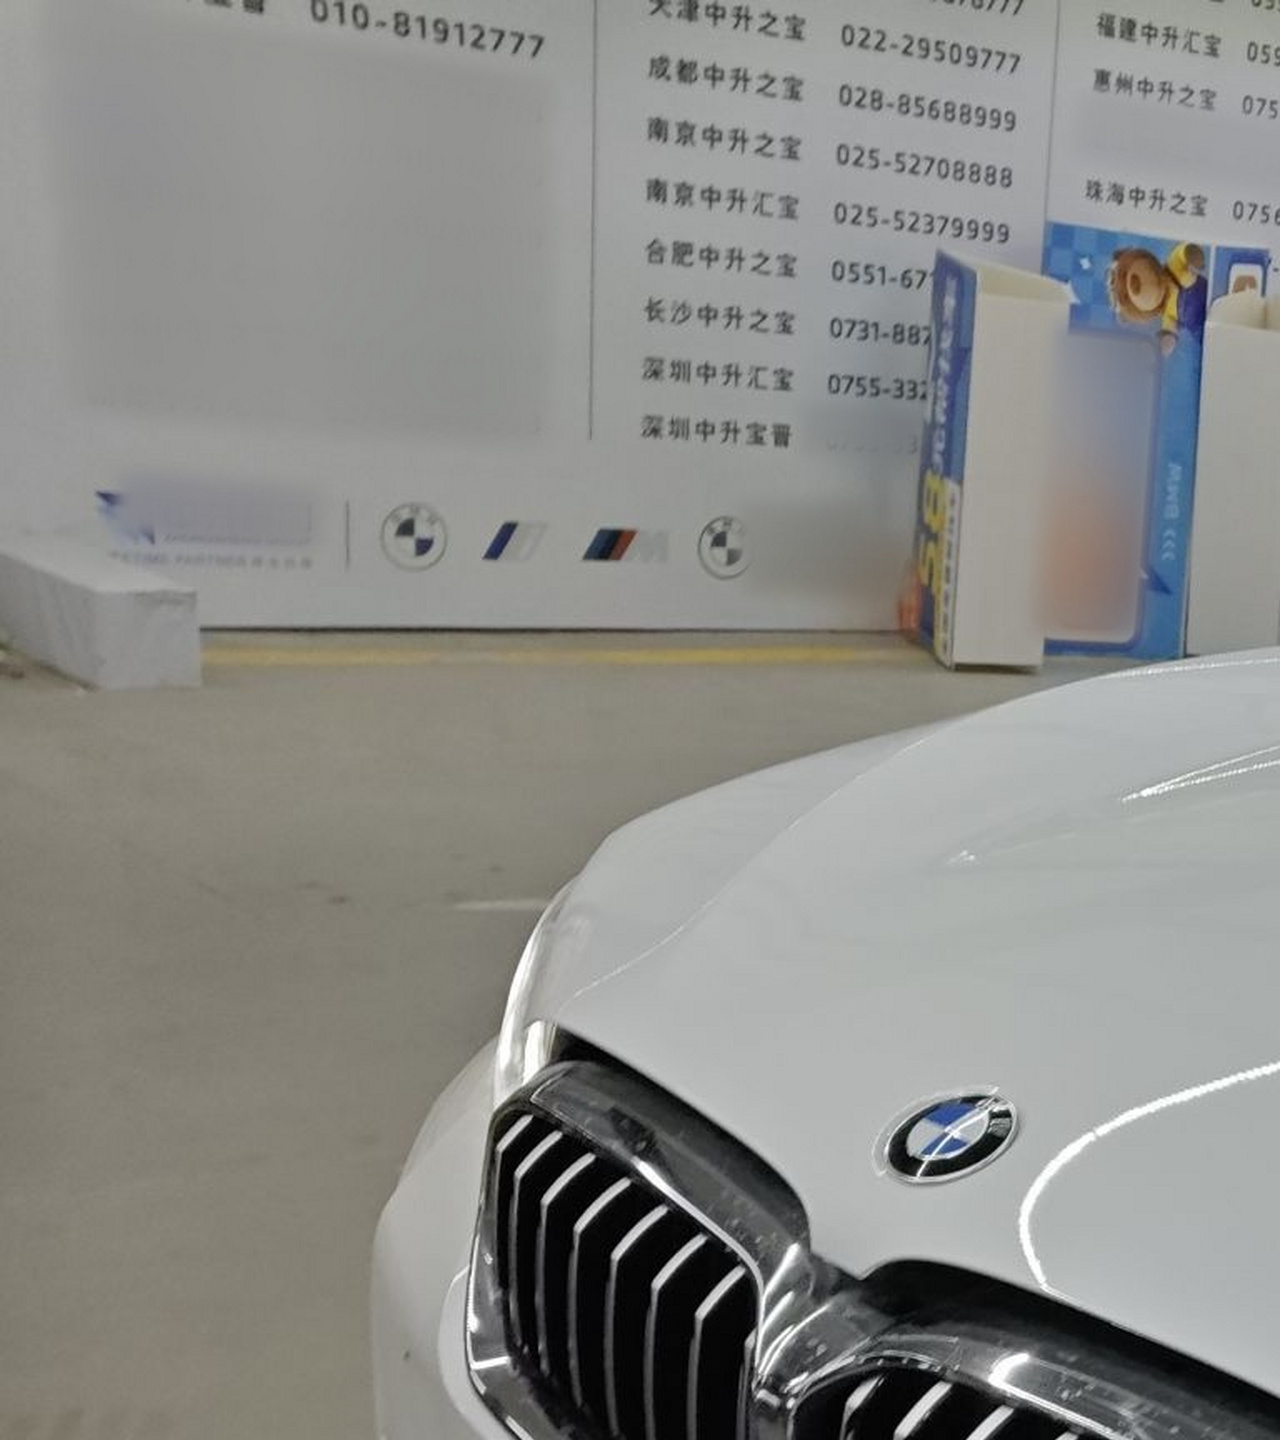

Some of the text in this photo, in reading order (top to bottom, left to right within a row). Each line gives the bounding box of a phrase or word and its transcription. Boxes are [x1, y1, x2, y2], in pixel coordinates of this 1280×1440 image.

[312, 0, 545, 57] 010-81912777
[841, 24, 1021, 74] 022-29509777
[838, 83, 1017, 132] 028-85688999
[836, 143, 1012, 189] 025-52708888
[834, 202, 1010, 244] 025-52379999
